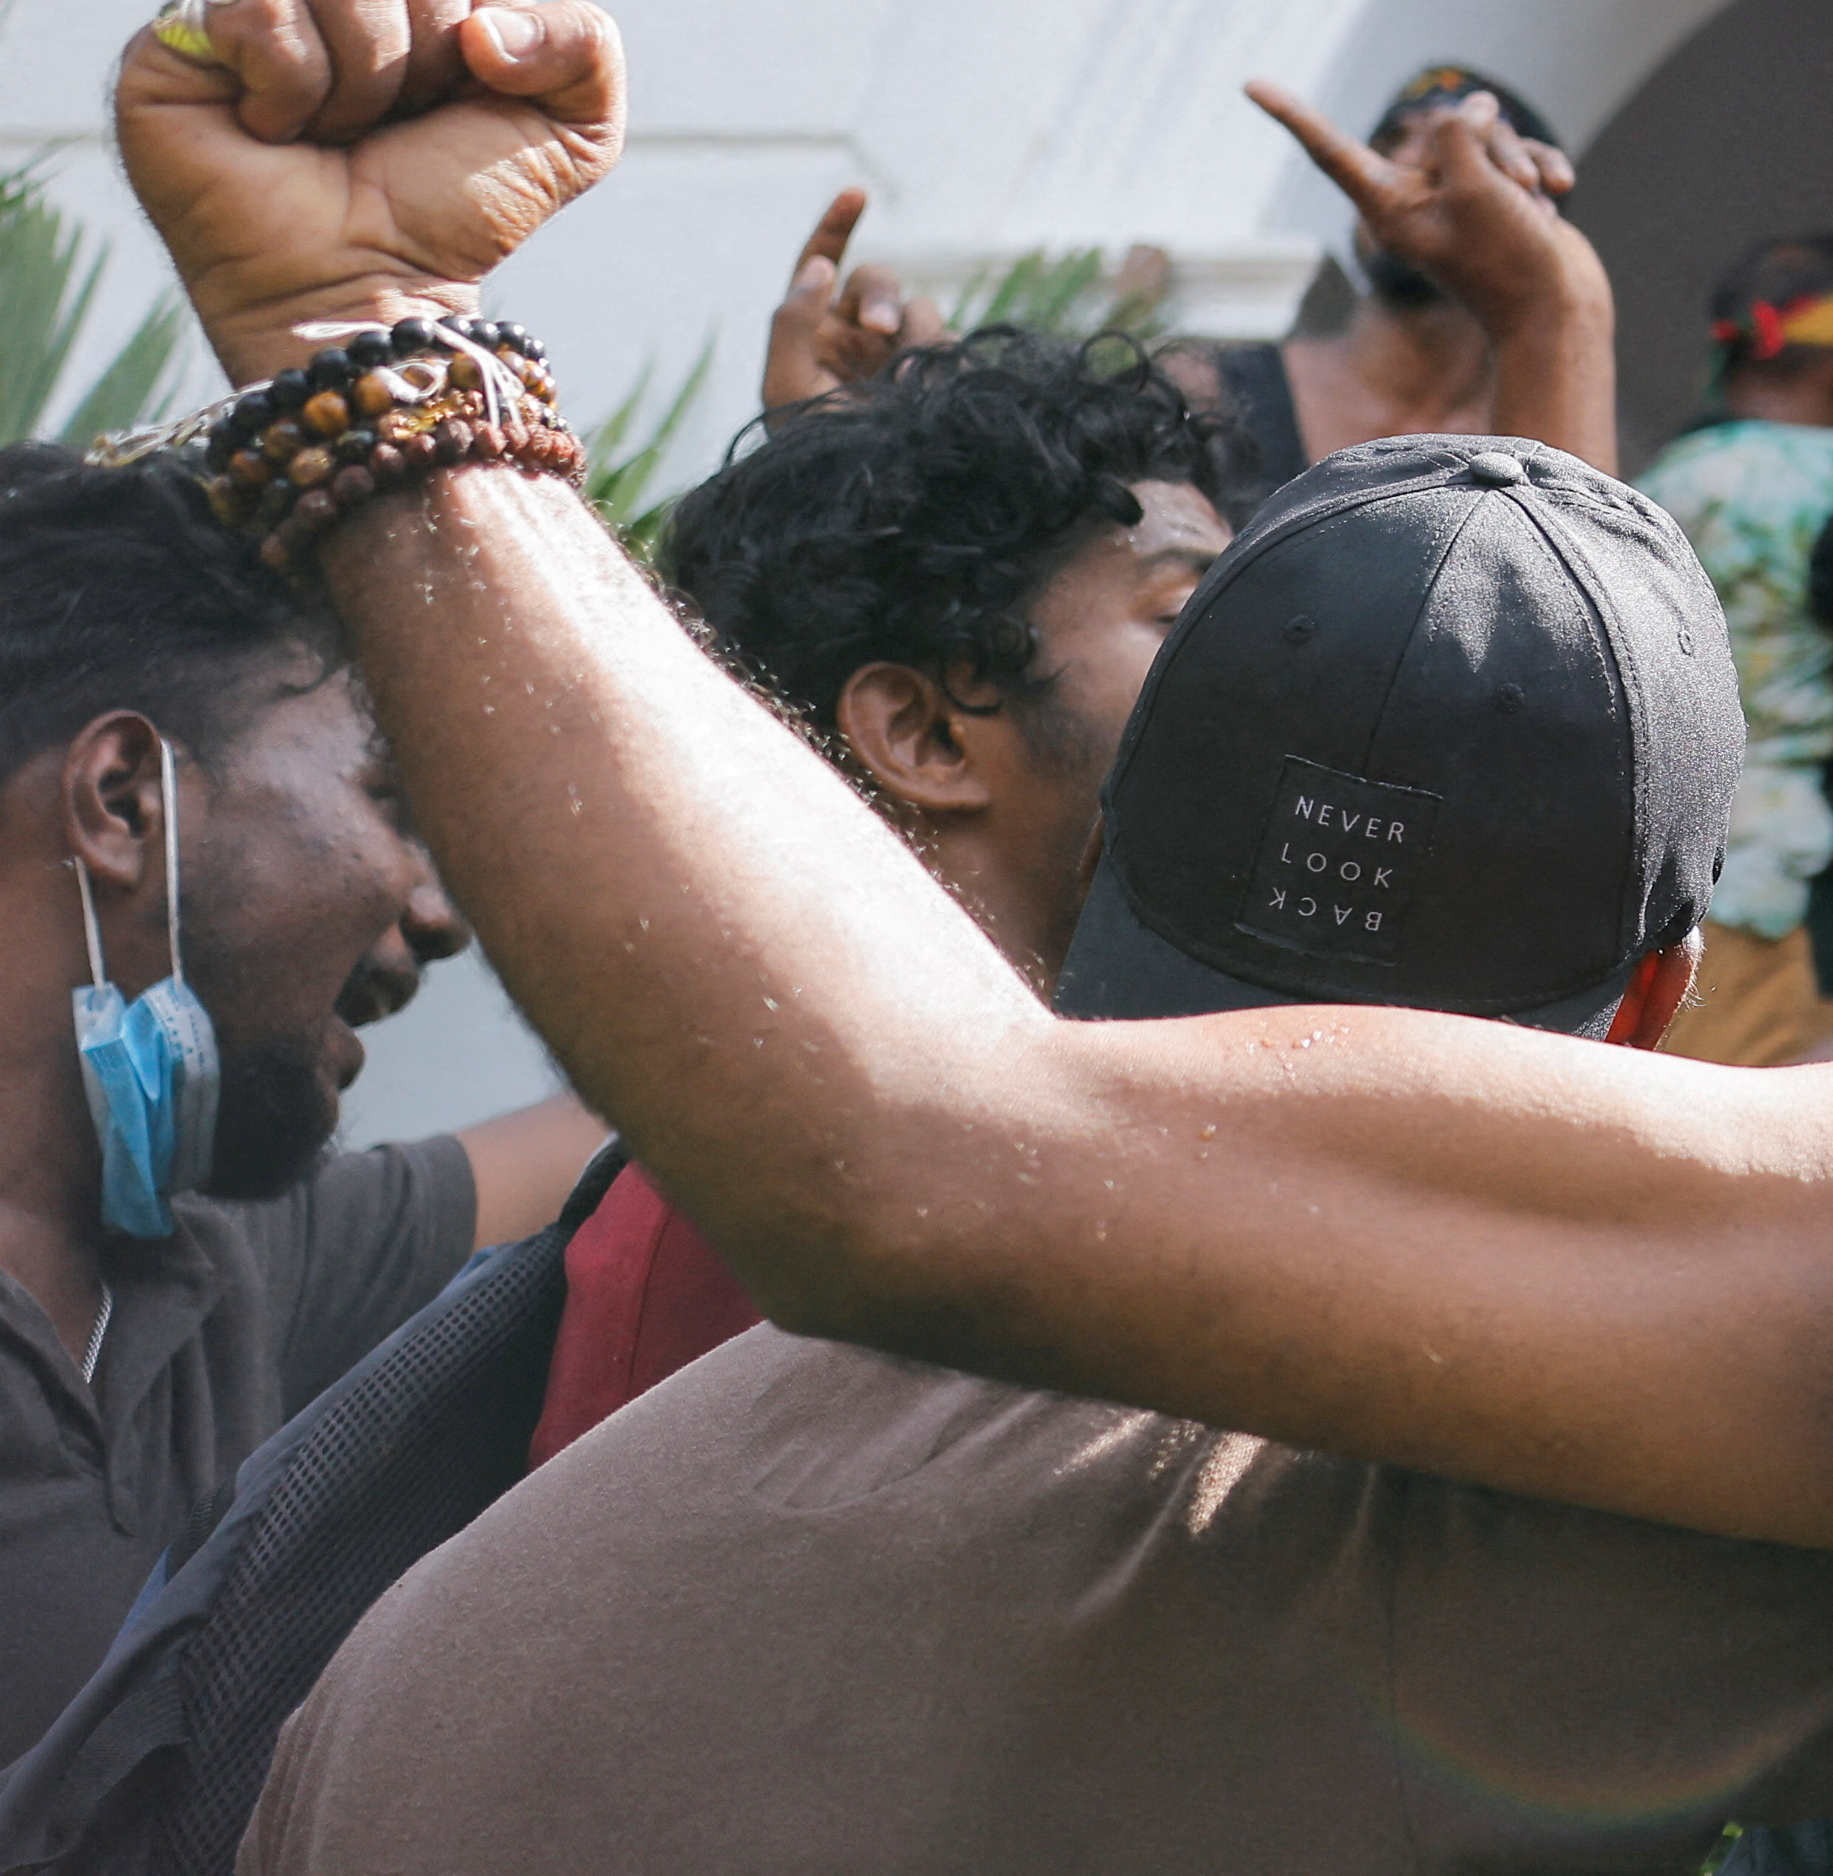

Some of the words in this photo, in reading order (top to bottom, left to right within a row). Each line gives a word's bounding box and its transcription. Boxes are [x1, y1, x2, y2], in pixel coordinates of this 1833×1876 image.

[1294, 794, 1405, 844] NEVER
[1281, 842, 1394, 889] LOOK
[1267, 886, 1383, 932] BACK
